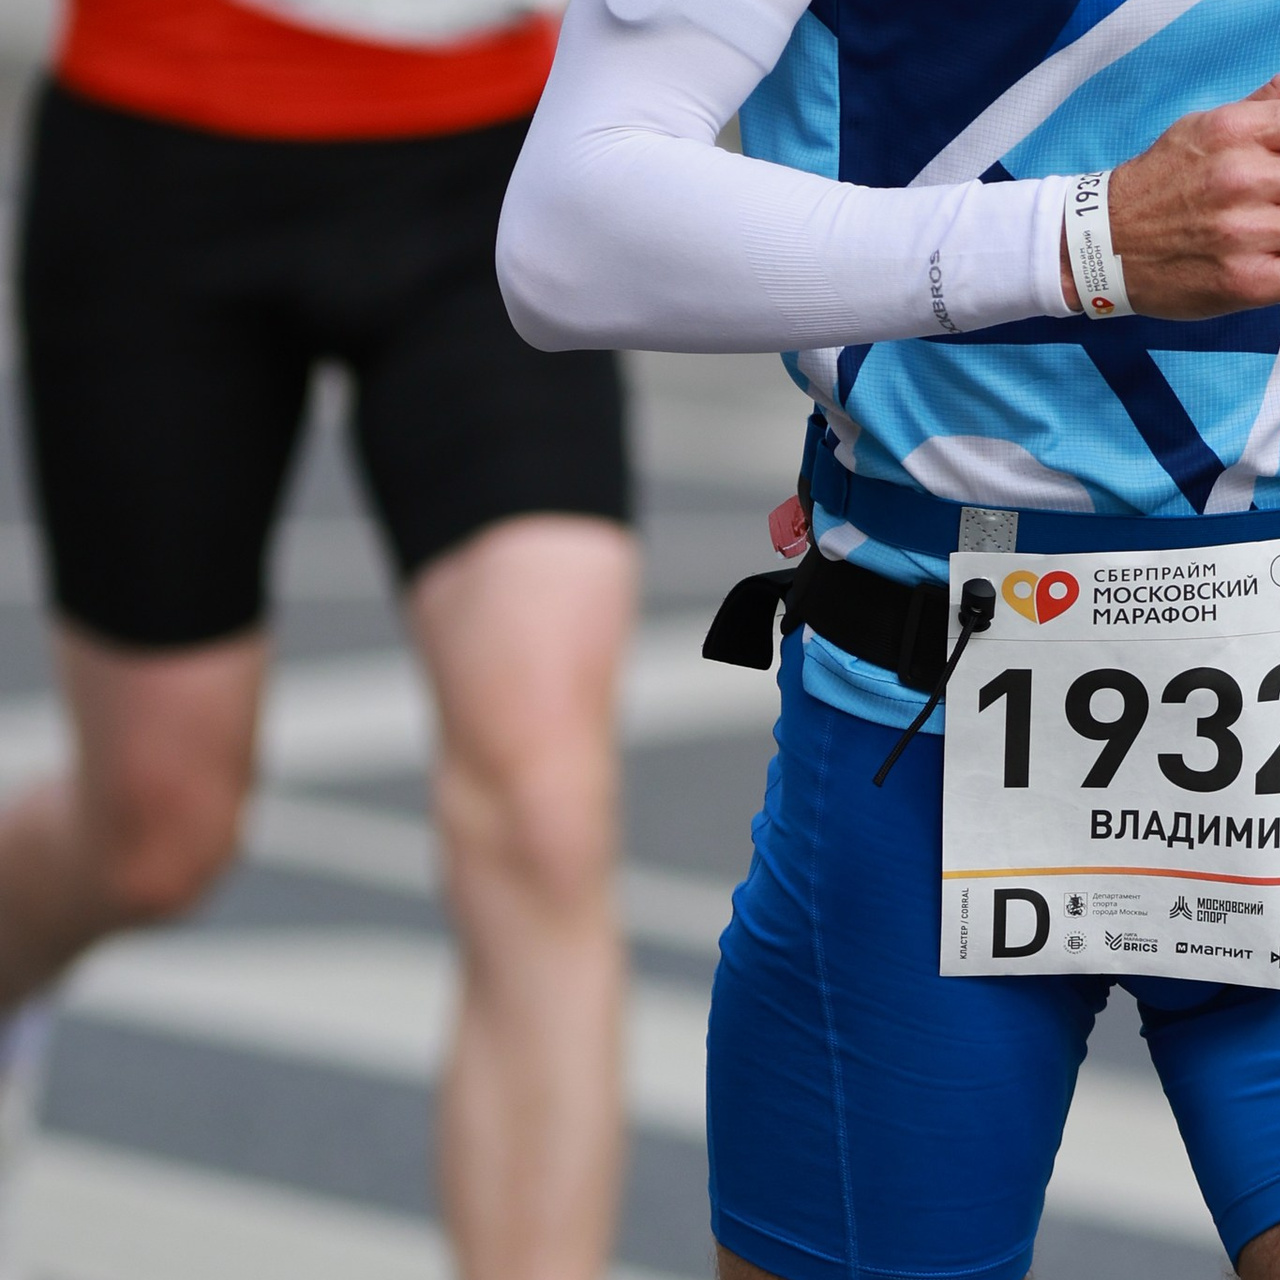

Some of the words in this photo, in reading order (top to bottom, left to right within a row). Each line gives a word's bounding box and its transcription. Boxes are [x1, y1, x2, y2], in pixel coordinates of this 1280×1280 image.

[1079, 247, 1093, 293] СБЕРПРАЙМ
[1083, 229, 1100, 292] МОСКОВСКИЙ
[1095, 245, 1109, 291] МАРАФОН
[1094, 561, 1216, 583] СБЕРПРАЙМ
[1093, 574, 1258, 604] МОСКОВСКИЙ
[1093, 604, 1217, 625] МАРАФОН
[1092, 892, 1141, 900] Департамент
[1197, 897, 1264, 916] МОСКОВСКИЙ
[992, 888, 1050, 958] D
[1197, 910, 1228, 924] СПОРТ
[960, 925, 968, 959] КЛАСТЕР
[1123, 942, 1158, 953] BRICS
